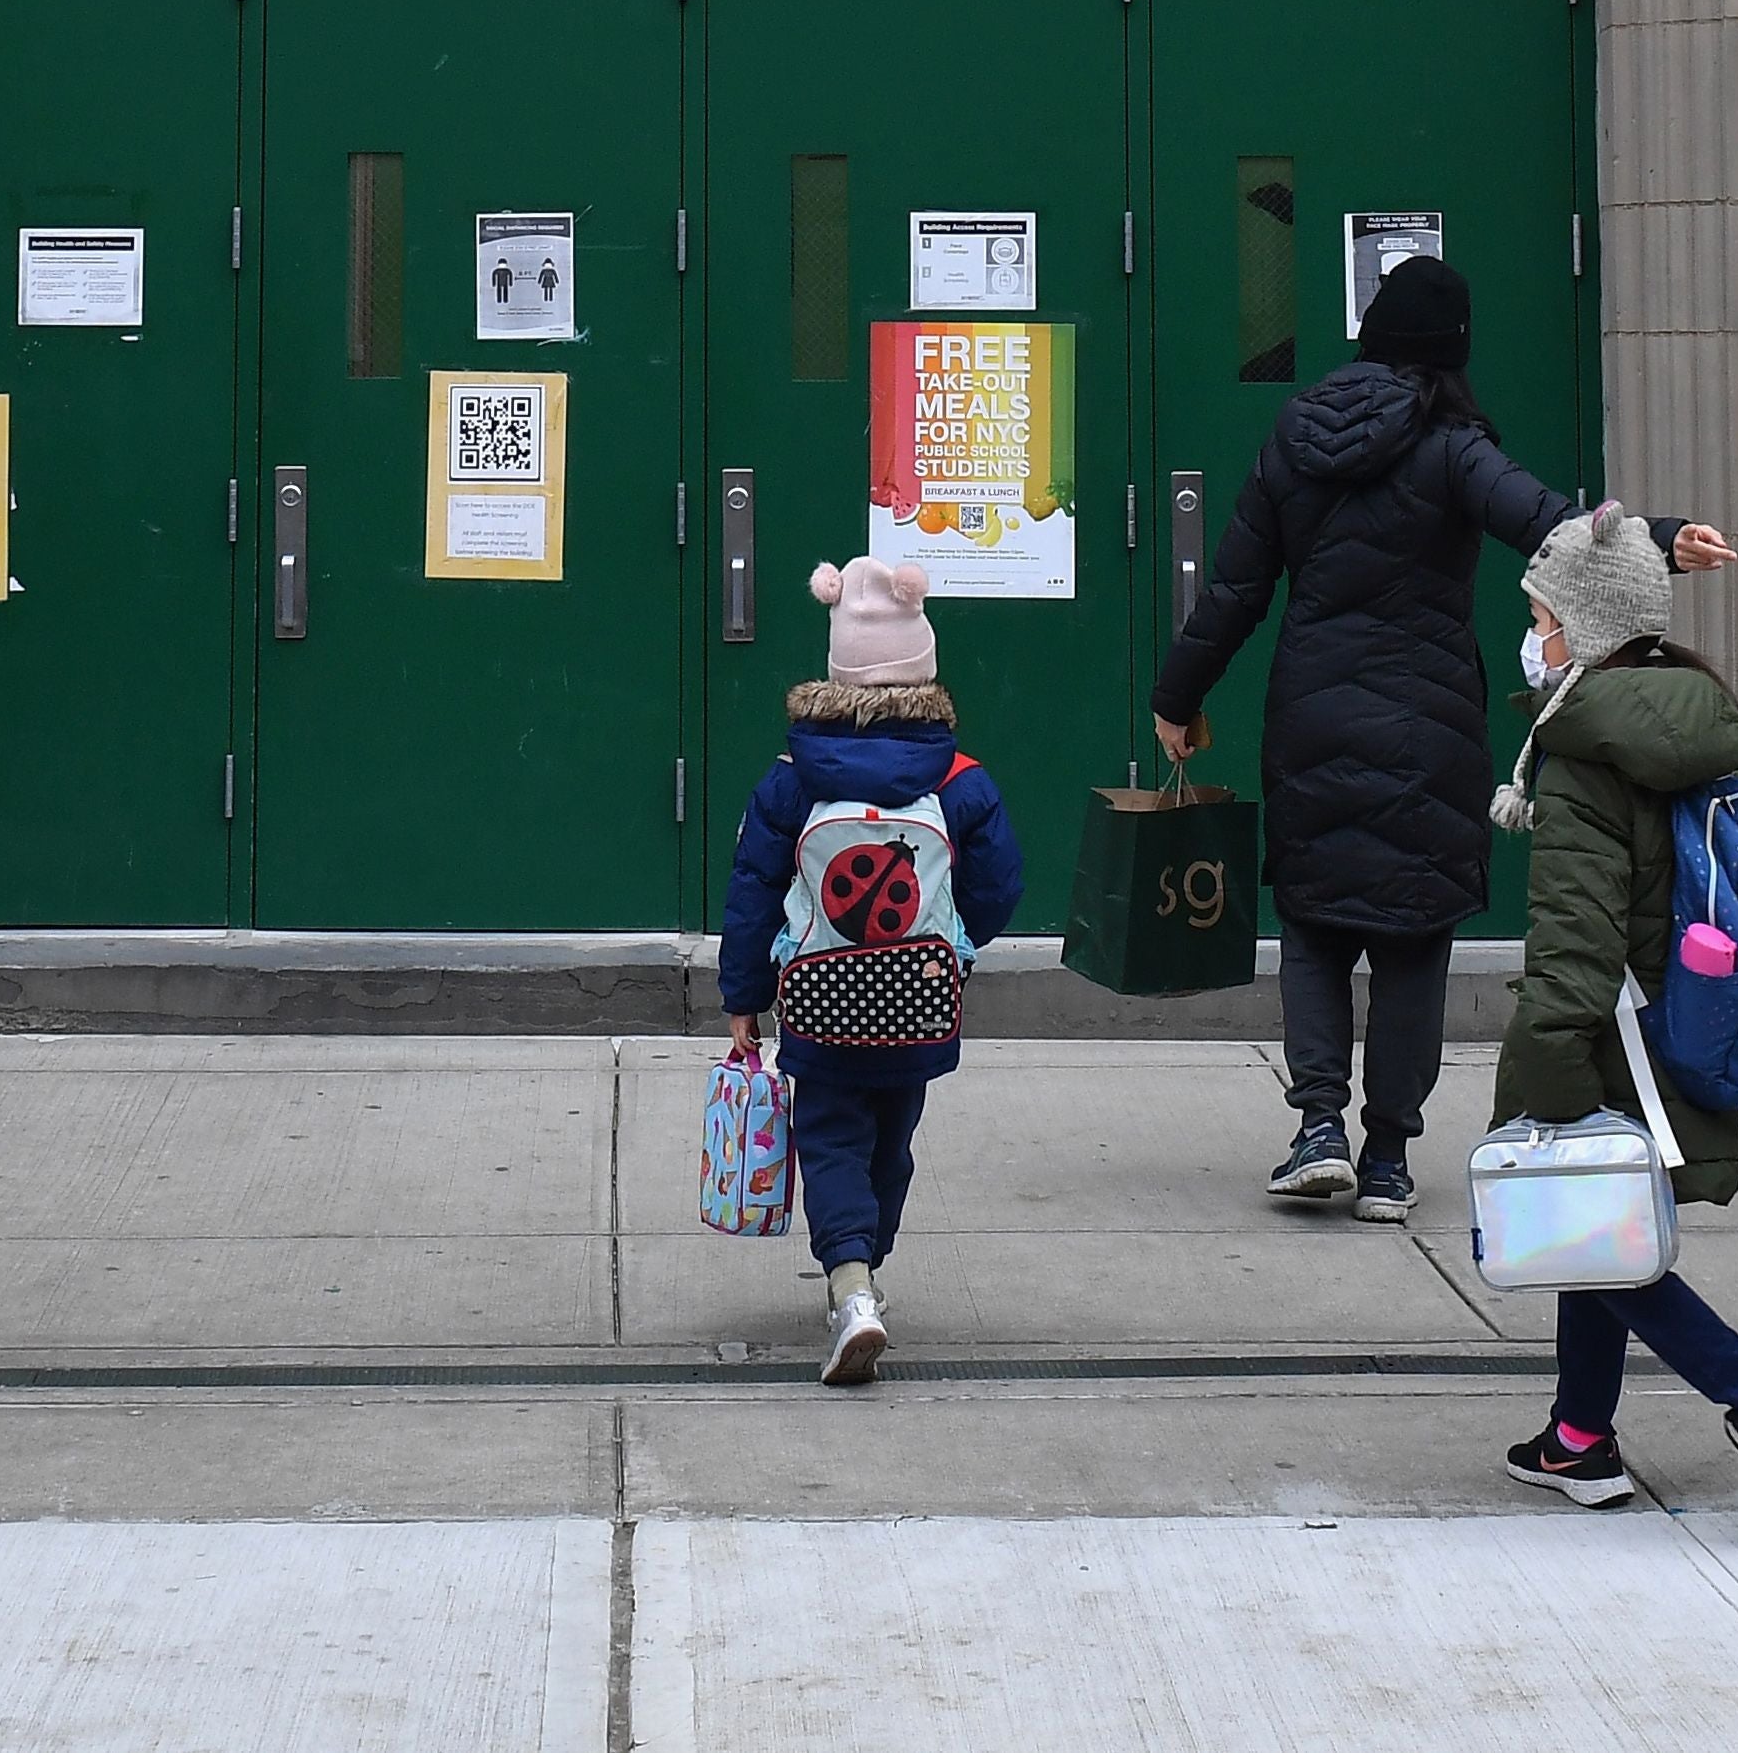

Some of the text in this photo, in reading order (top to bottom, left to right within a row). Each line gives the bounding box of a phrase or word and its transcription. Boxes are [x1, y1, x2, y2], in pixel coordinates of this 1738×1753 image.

[914, 335, 1031, 371] FREE
[915, 372, 1031, 392] TAKE-OUT
[915, 394, 1031, 420] MEALS
[914, 421, 1031, 444] FOR NYC
[914, 445, 1030, 458] PUBLIC SCHOOL
[913, 459, 1031, 478] STUDENTS
[925, 488, 977, 496] BREAKFAST
[988, 489, 1020, 497] LUNCH
[1156, 860, 1225, 929] sg
